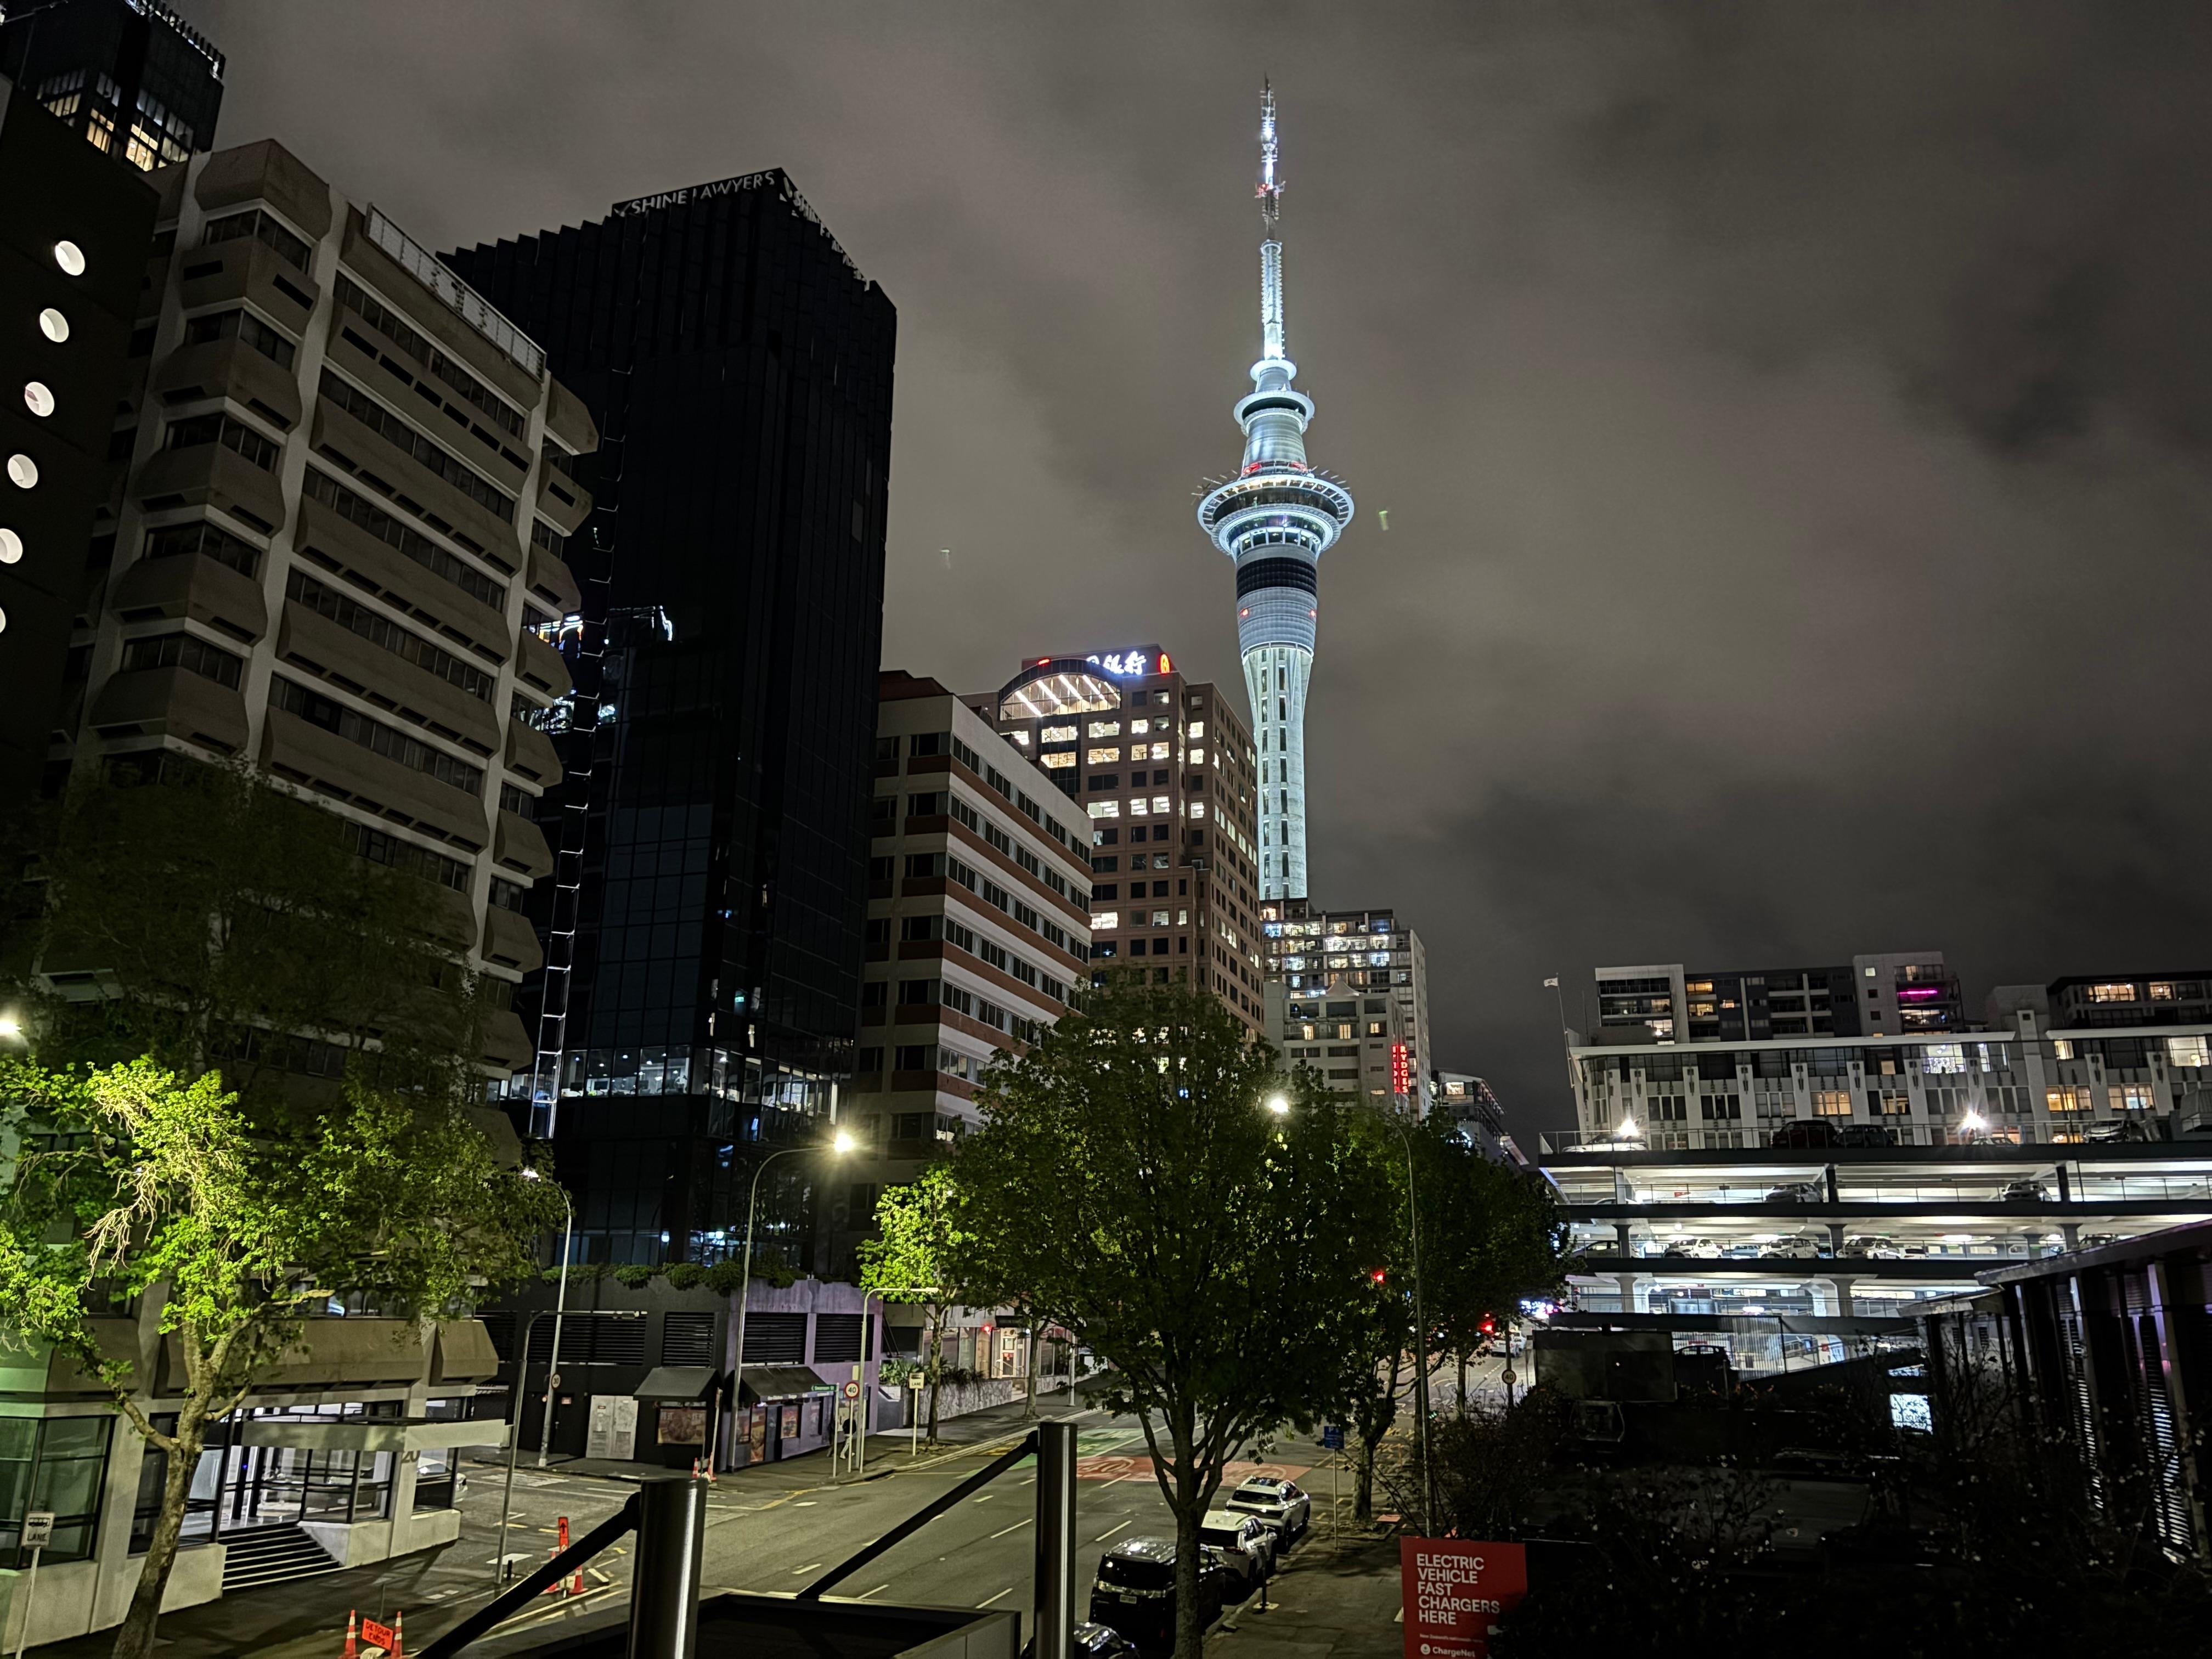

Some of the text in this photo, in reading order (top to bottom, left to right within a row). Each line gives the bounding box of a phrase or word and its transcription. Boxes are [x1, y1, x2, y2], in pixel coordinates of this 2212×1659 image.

[631, 190, 687, 214] SHINE
[1400, 1045, 1409, 1093] RYDGES
[27, 1533, 47, 1542] LANE
[1417, 1553, 1485, 1570] ELECTRIC
[1418, 1567, 1478, 1584] VEHICLE
[1417, 1581, 1453, 1596] FAST
[1418, 1595, 1500, 1614] CHARGERS
[1419, 1609, 1457, 1626] HERE
[366, 1622, 390, 1637] DETOUR
[369, 1632, 385, 1645] ENDS
[1432, 1646, 1476, 1658] ChargeNet
